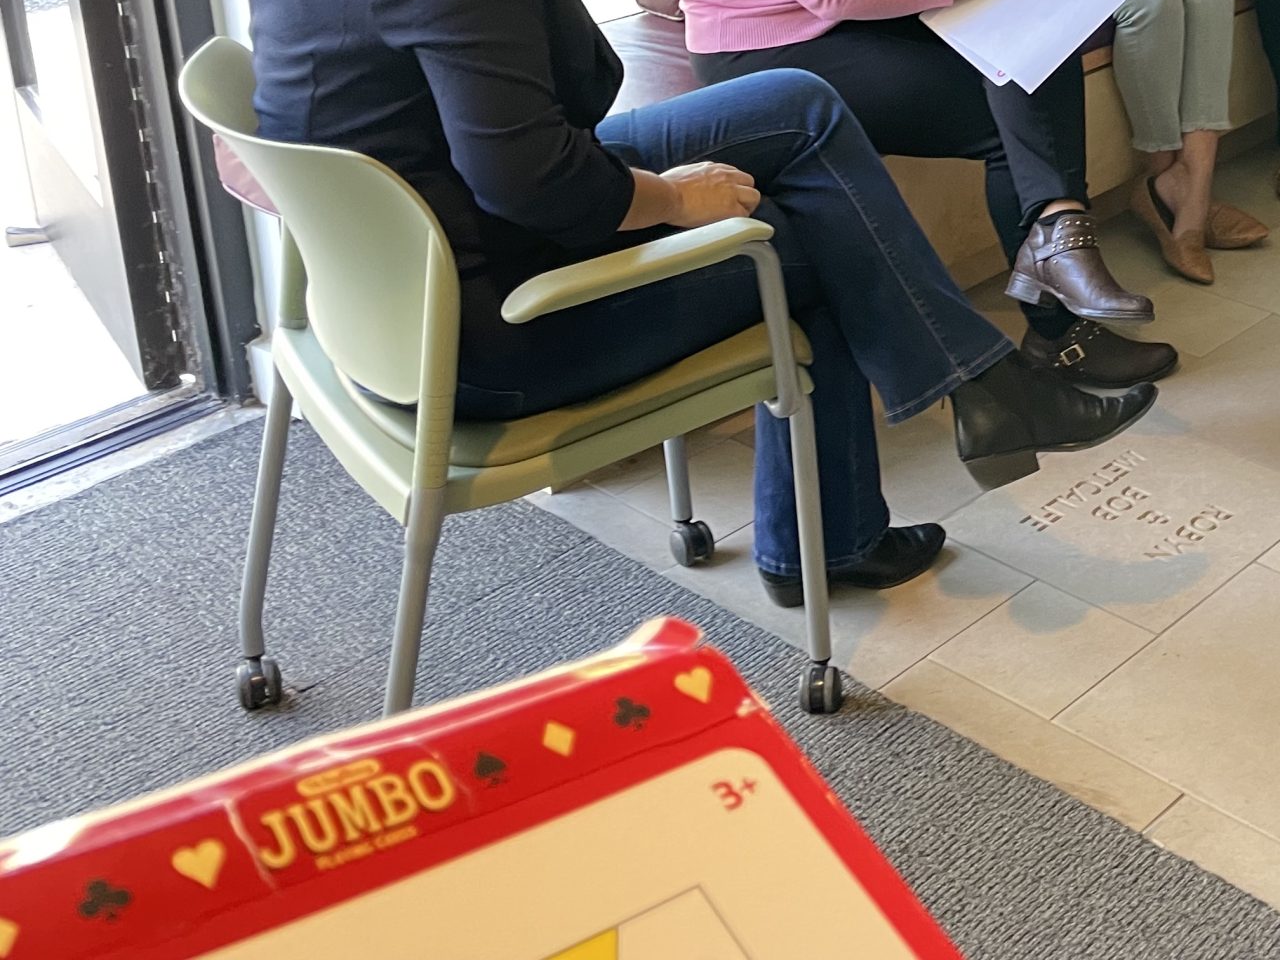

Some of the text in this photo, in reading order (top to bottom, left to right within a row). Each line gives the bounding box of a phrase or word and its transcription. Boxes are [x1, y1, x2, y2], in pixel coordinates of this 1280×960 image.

[1019, 449, 1148, 532] METCALFE
[1091, 486, 1152, 521] BOB
[1143, 504, 1236, 561] ROBYN
[260, 760, 455, 870] JUMBO
[710, 777, 758, 812] 3+
